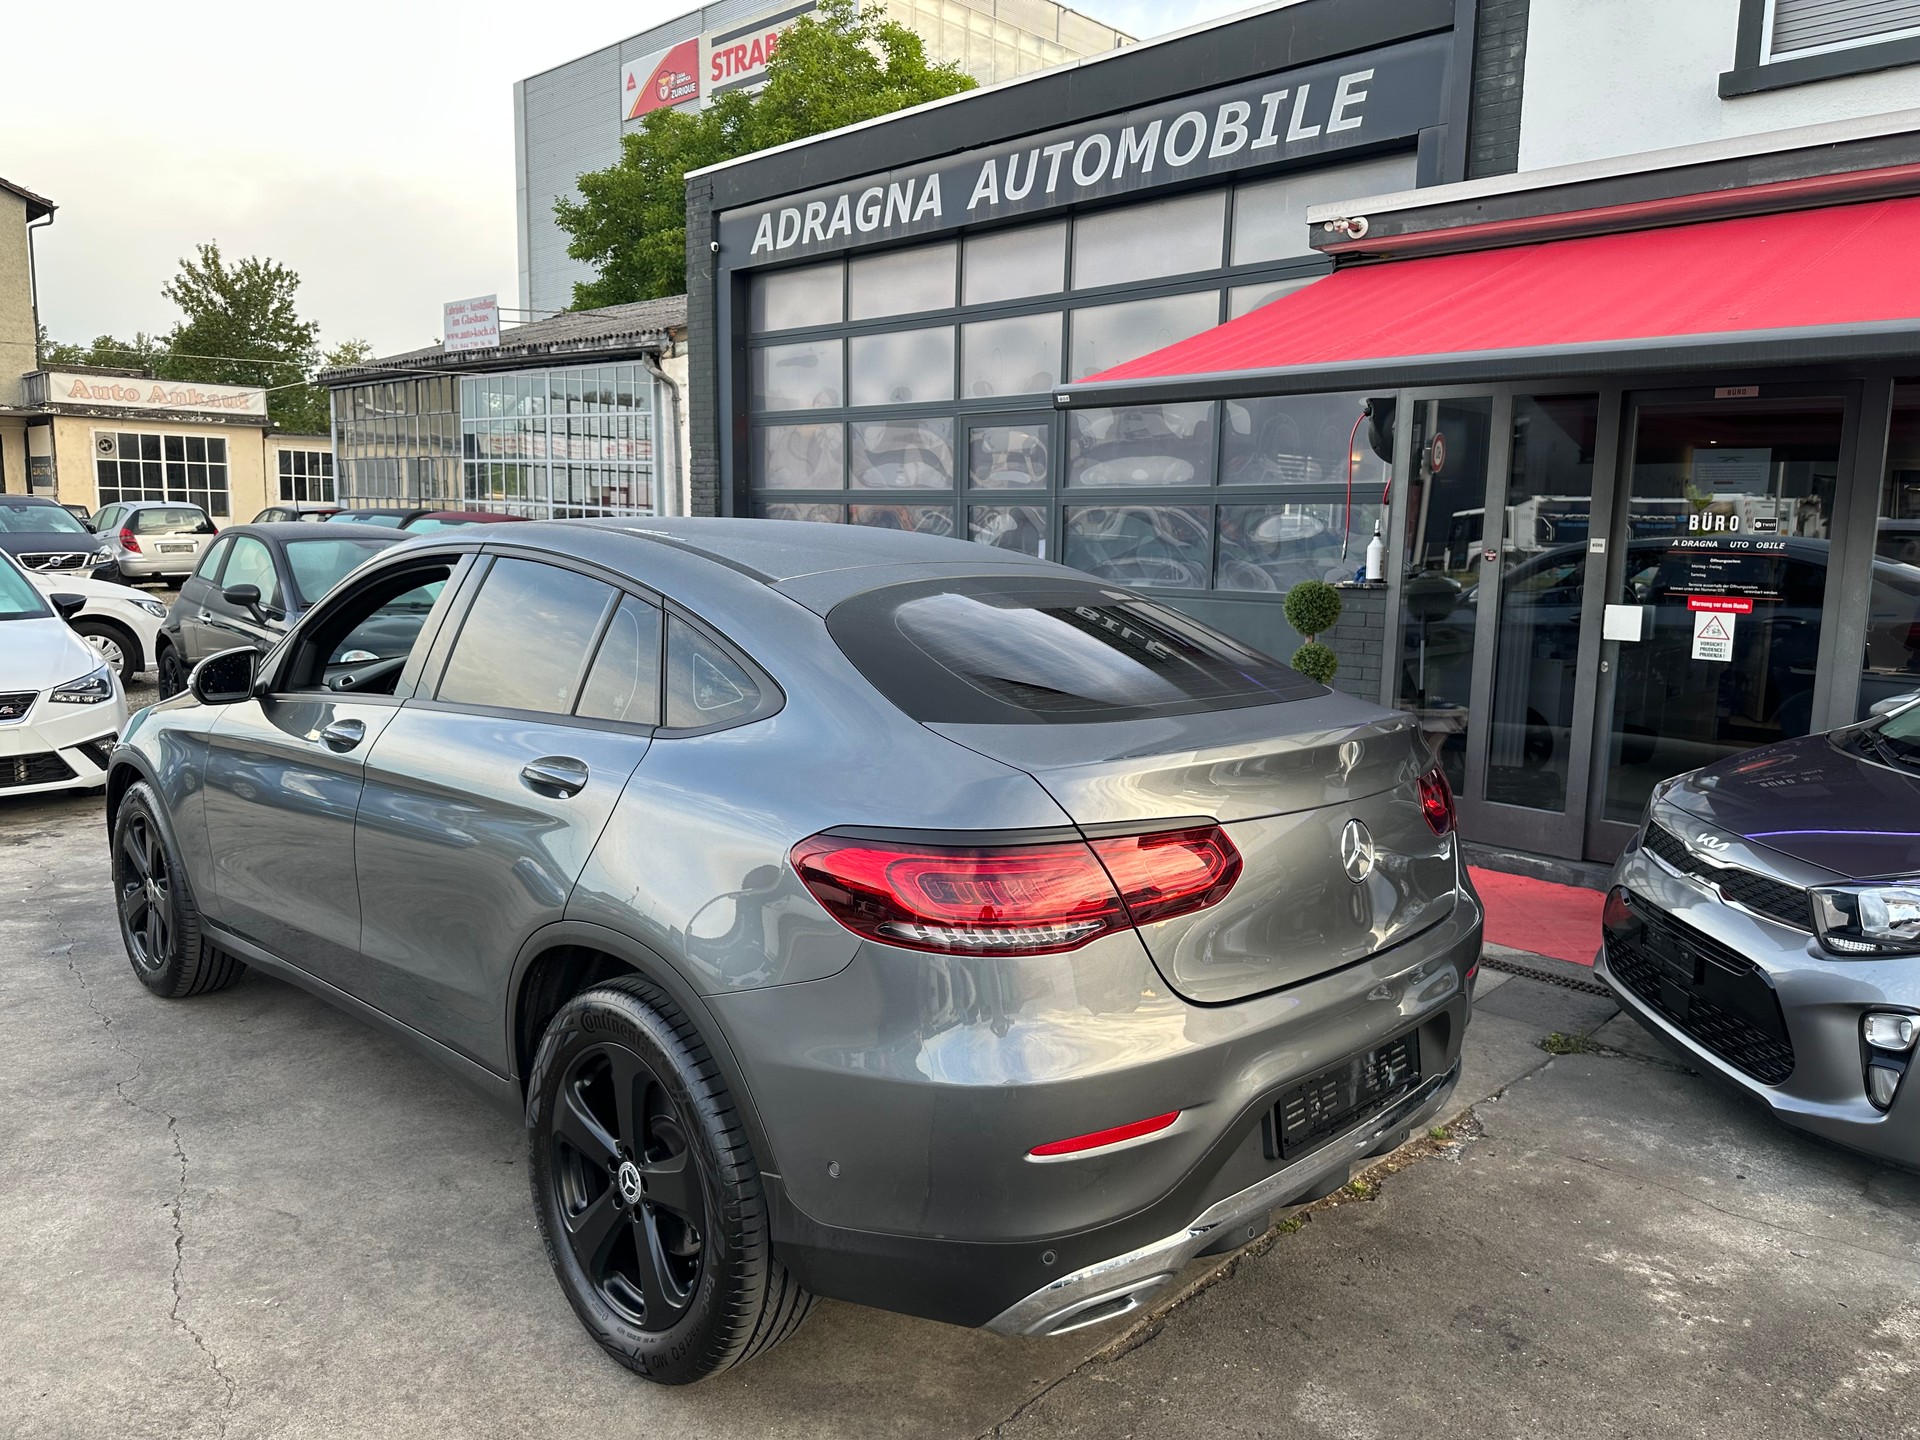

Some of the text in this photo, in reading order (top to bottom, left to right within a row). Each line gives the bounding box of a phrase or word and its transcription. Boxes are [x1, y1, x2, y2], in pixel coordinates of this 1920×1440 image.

[711, 33, 778, 82] STRAB
[671, 82, 696, 99] ZURIQUE
[750, 68, 1375, 255] ADRAGNA AUTOMOBILE
[68, 379, 250, 410] Auto Ankauf
[1689, 512, 1739, 531] BÜRO
[1691, 600, 1713, 608] Warnung
[580, 1010, 656, 1062] Continental
